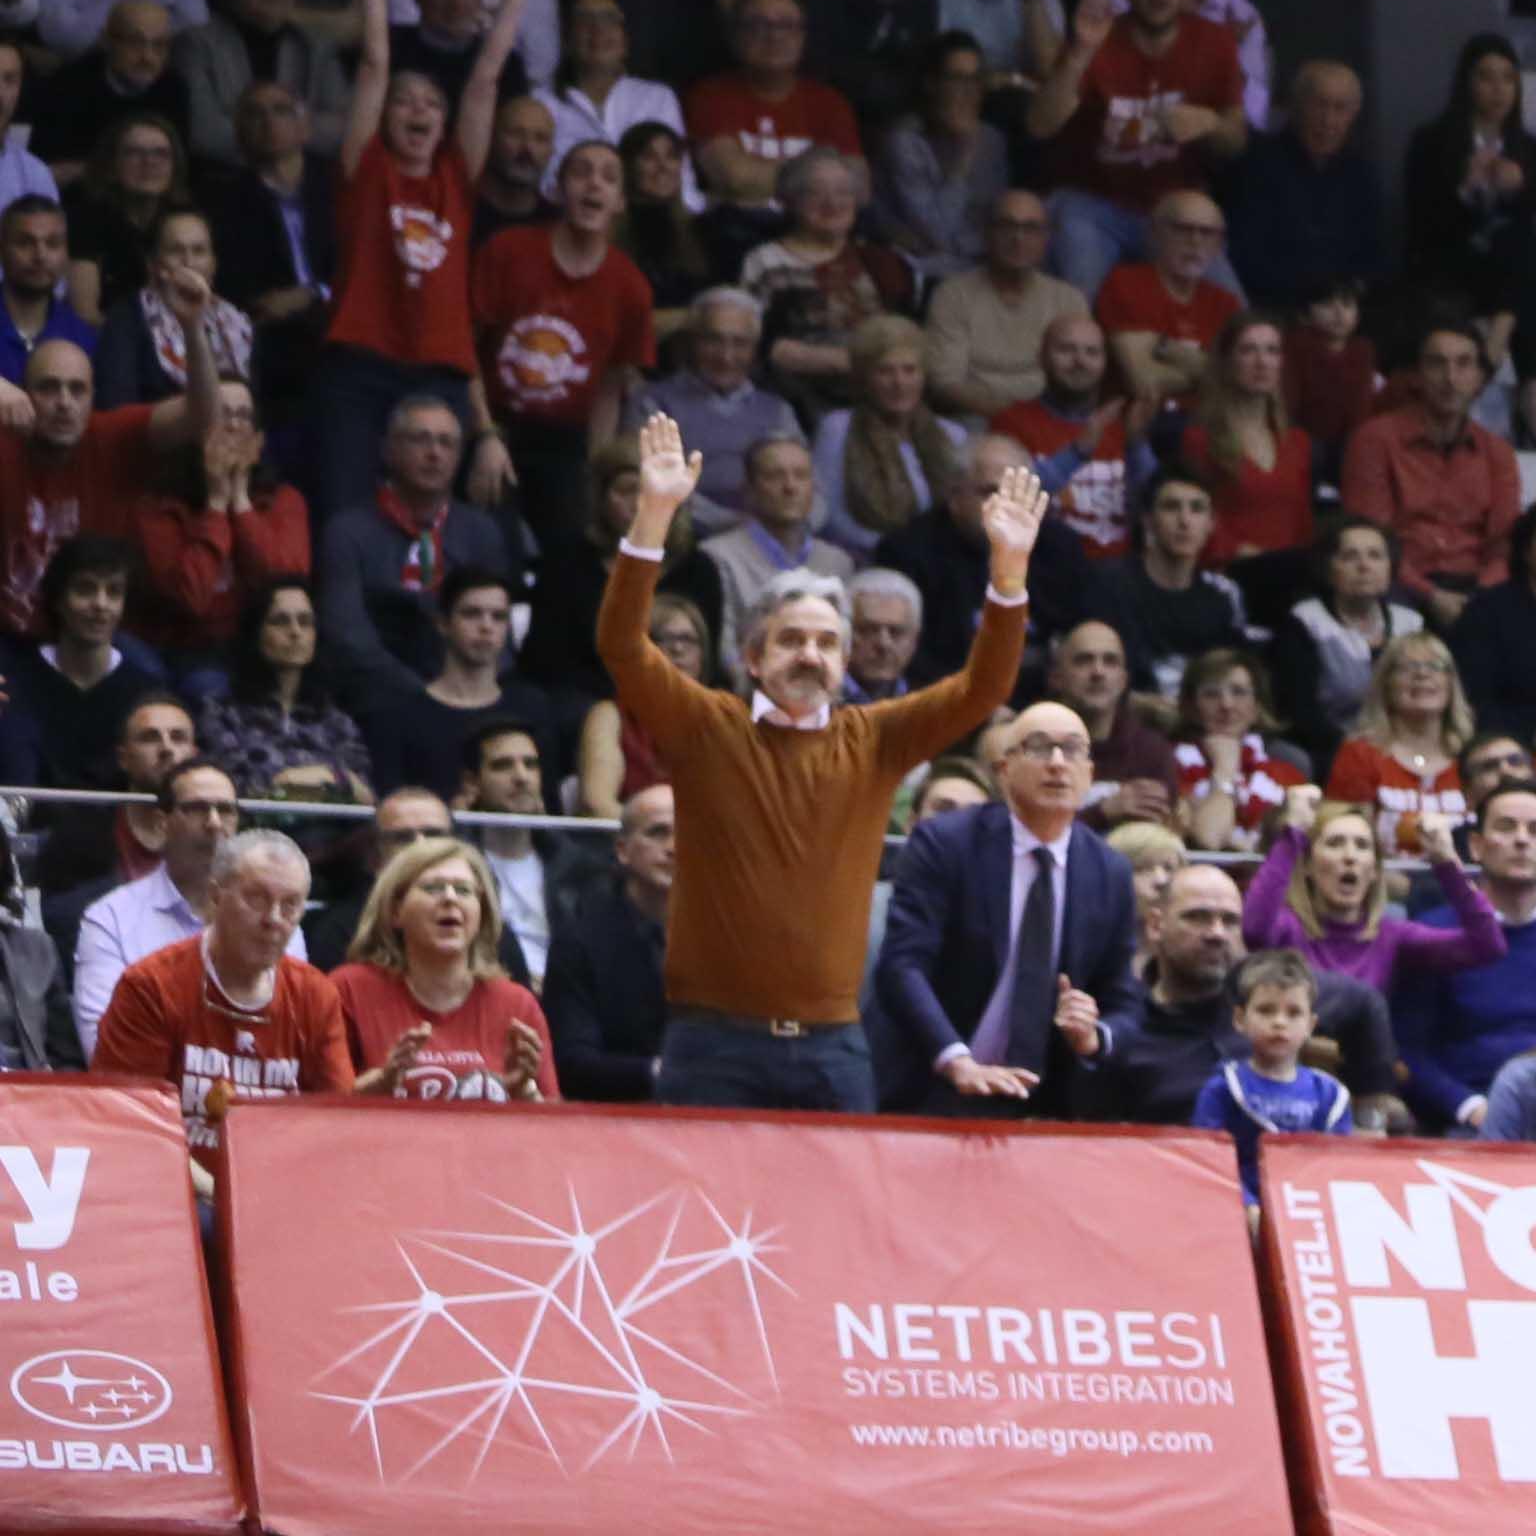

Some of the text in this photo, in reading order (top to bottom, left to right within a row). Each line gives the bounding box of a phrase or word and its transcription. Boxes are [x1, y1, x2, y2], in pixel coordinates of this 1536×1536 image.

[184, 1043, 301, 1090] NOT IN MY
[0, 1145, 92, 1251] y
[0, 1261, 79, 1302] ale
[834, 1302, 1226, 1368] NETRIBESI
[1284, 1182, 1371, 1477] NOVAHOTEL.IT
[843, 1366, 1235, 1406] SYSTEMS INTEGRATION
[0, 1439, 215, 1475] SUBARU
[851, 1422, 1214, 1456] www.netribegroup.com
